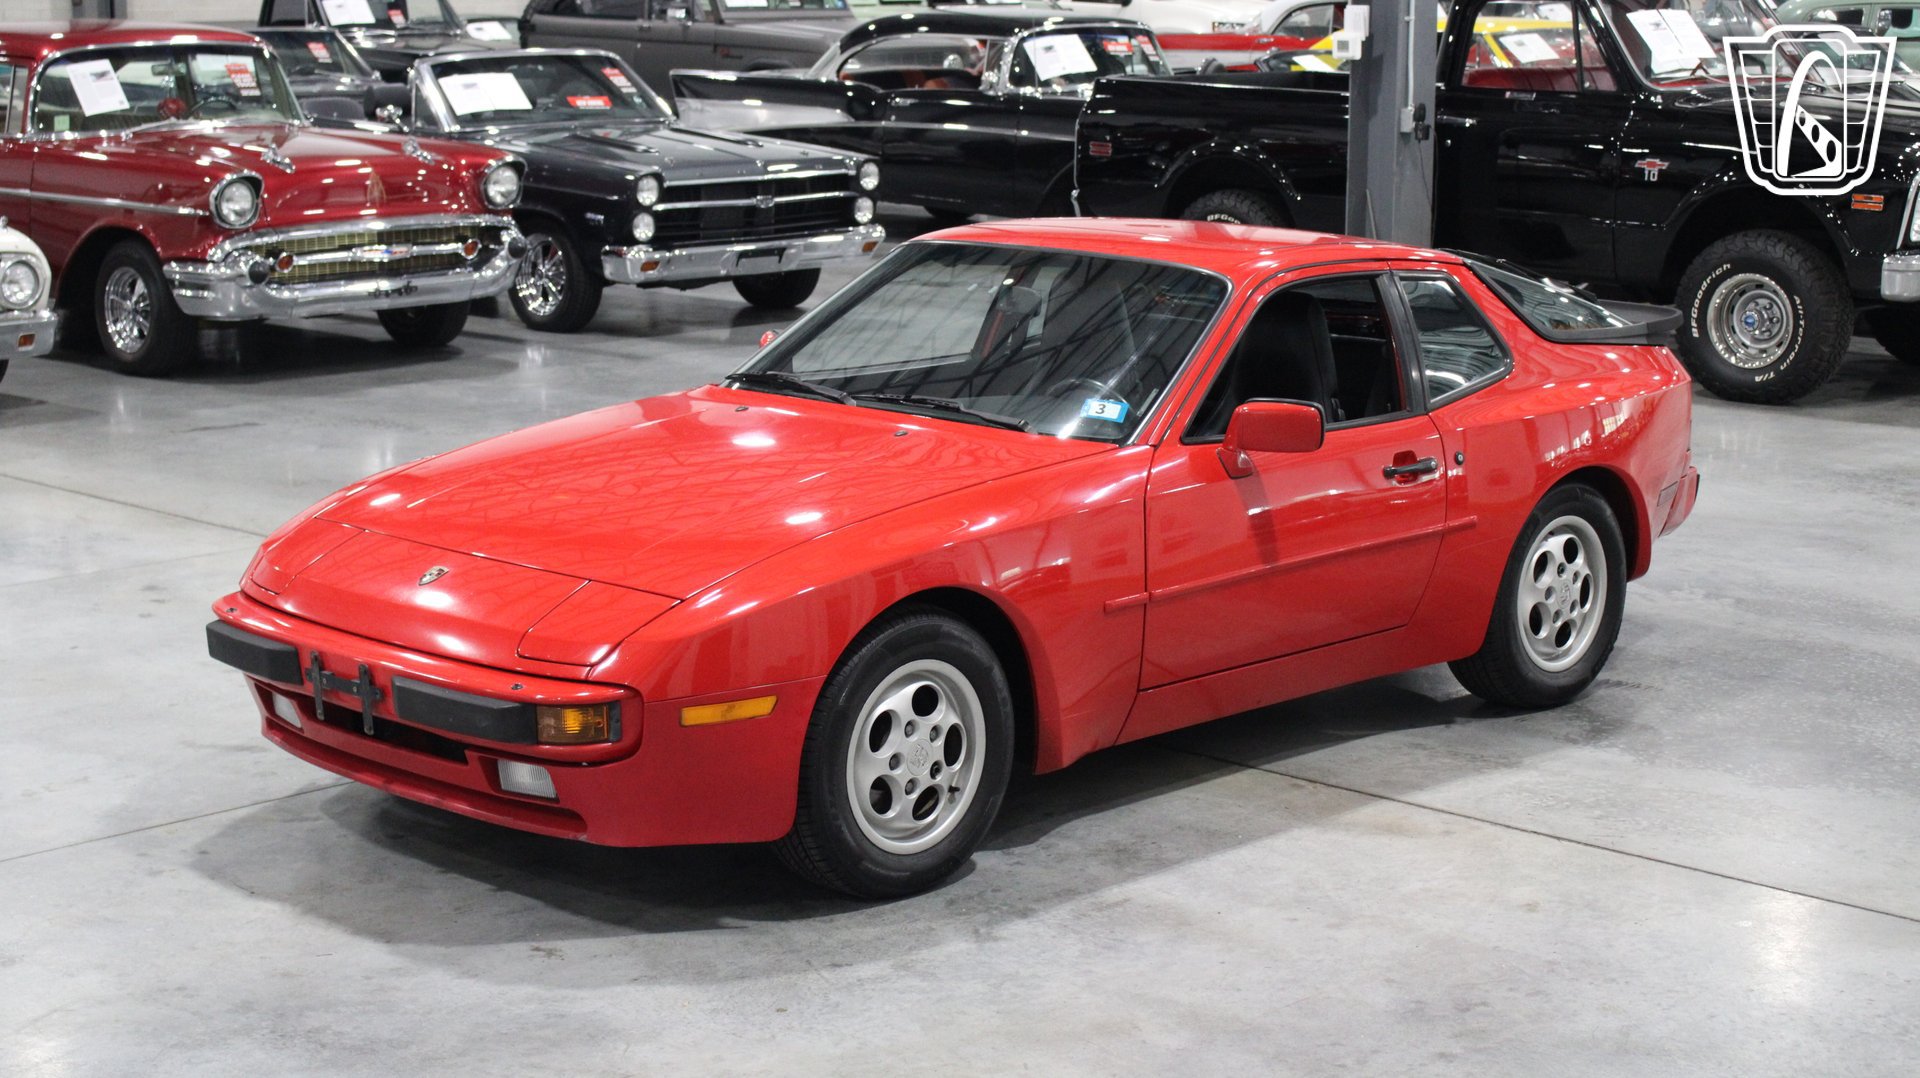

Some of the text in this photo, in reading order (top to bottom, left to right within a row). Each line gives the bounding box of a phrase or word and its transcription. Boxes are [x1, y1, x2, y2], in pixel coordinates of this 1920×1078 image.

[1644, 170, 1658, 181] 10
[1691, 263, 1731, 338] BFGoodrich
[1754, 295, 1805, 382] All-Terrain T/A
[1095, 403, 1107, 415] 3
